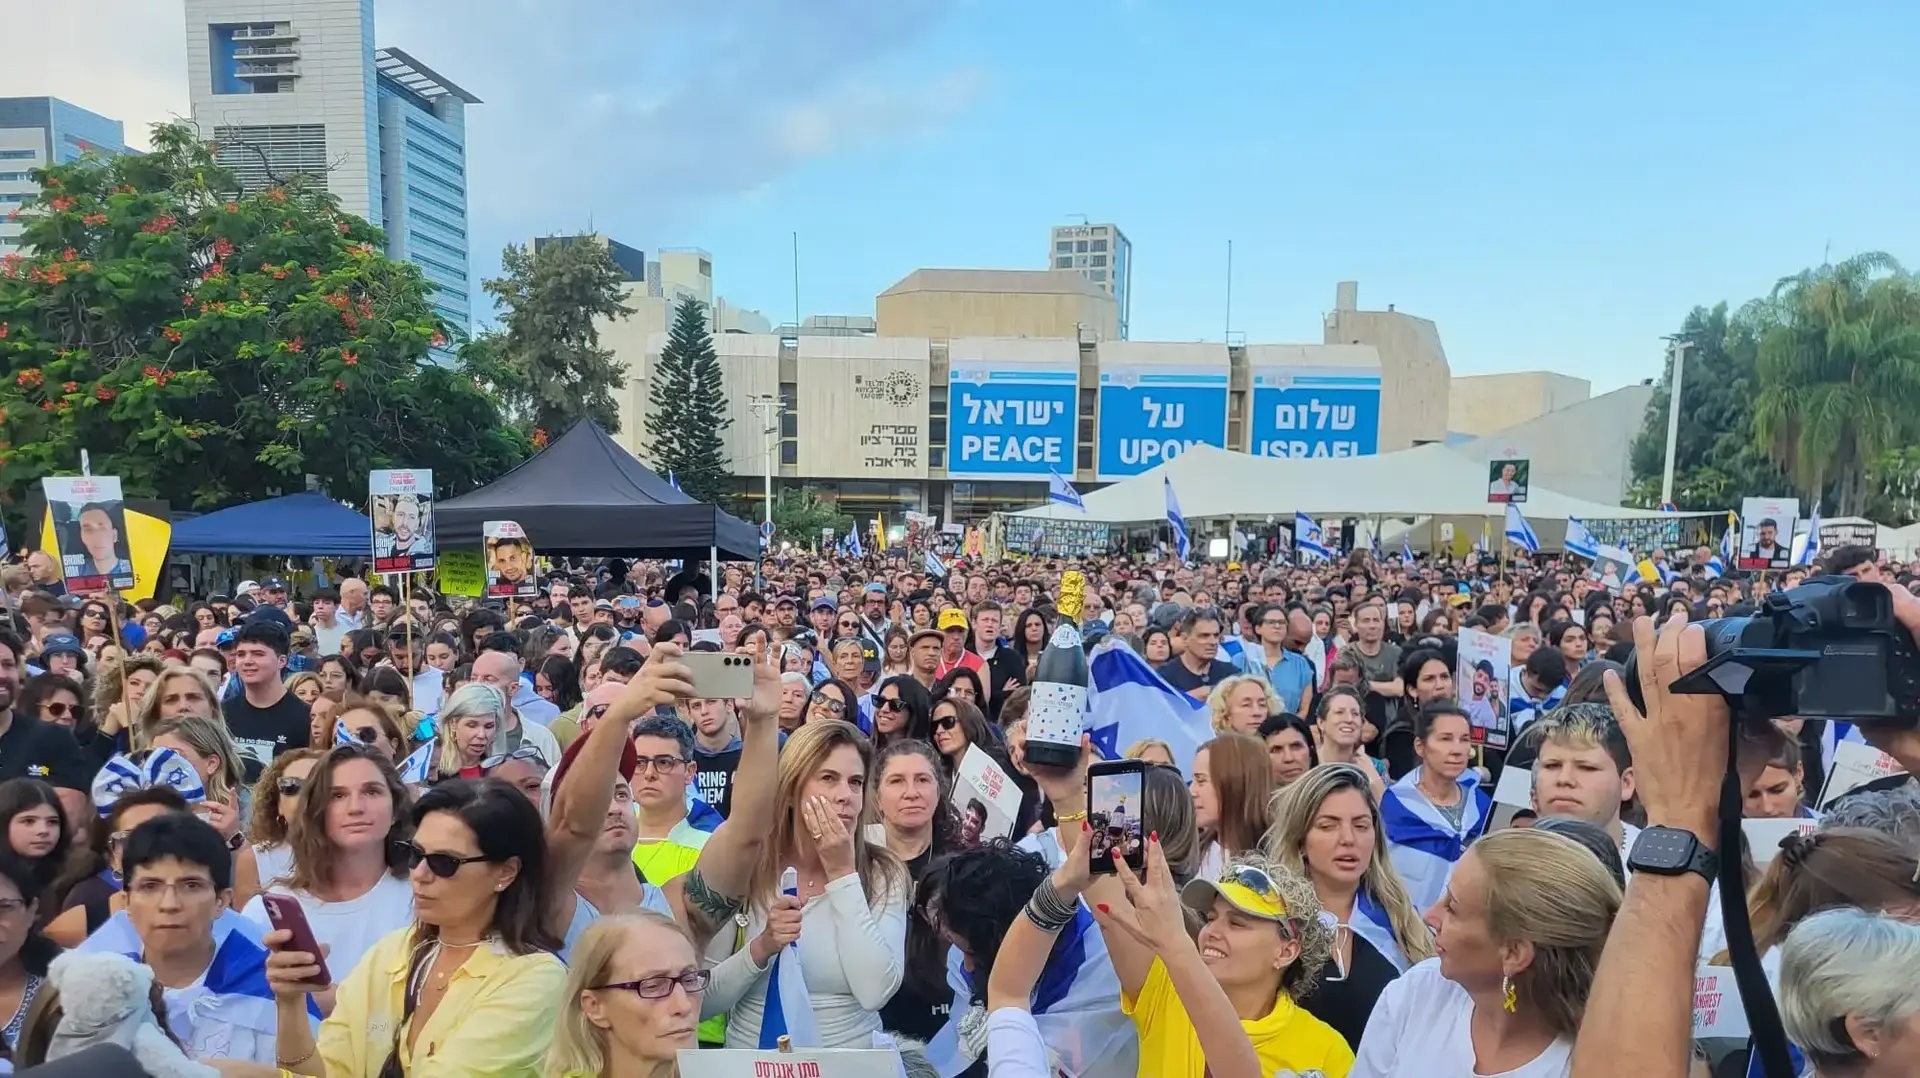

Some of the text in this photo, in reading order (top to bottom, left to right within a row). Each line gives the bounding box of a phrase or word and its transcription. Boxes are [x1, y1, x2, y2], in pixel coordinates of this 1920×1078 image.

[962, 393, 1064, 425] ישראל
[1142, 396, 1185, 428] על
[1275, 398, 1356, 430] שלום
[871, 425, 917, 434] ספריית
[894, 447, 917, 457] בית
[961, 435, 1062, 462] PEACE
[864, 457, 917, 467] אריאלה
[863, 649, 875, 658] M
[698, 771, 727, 787] RING
